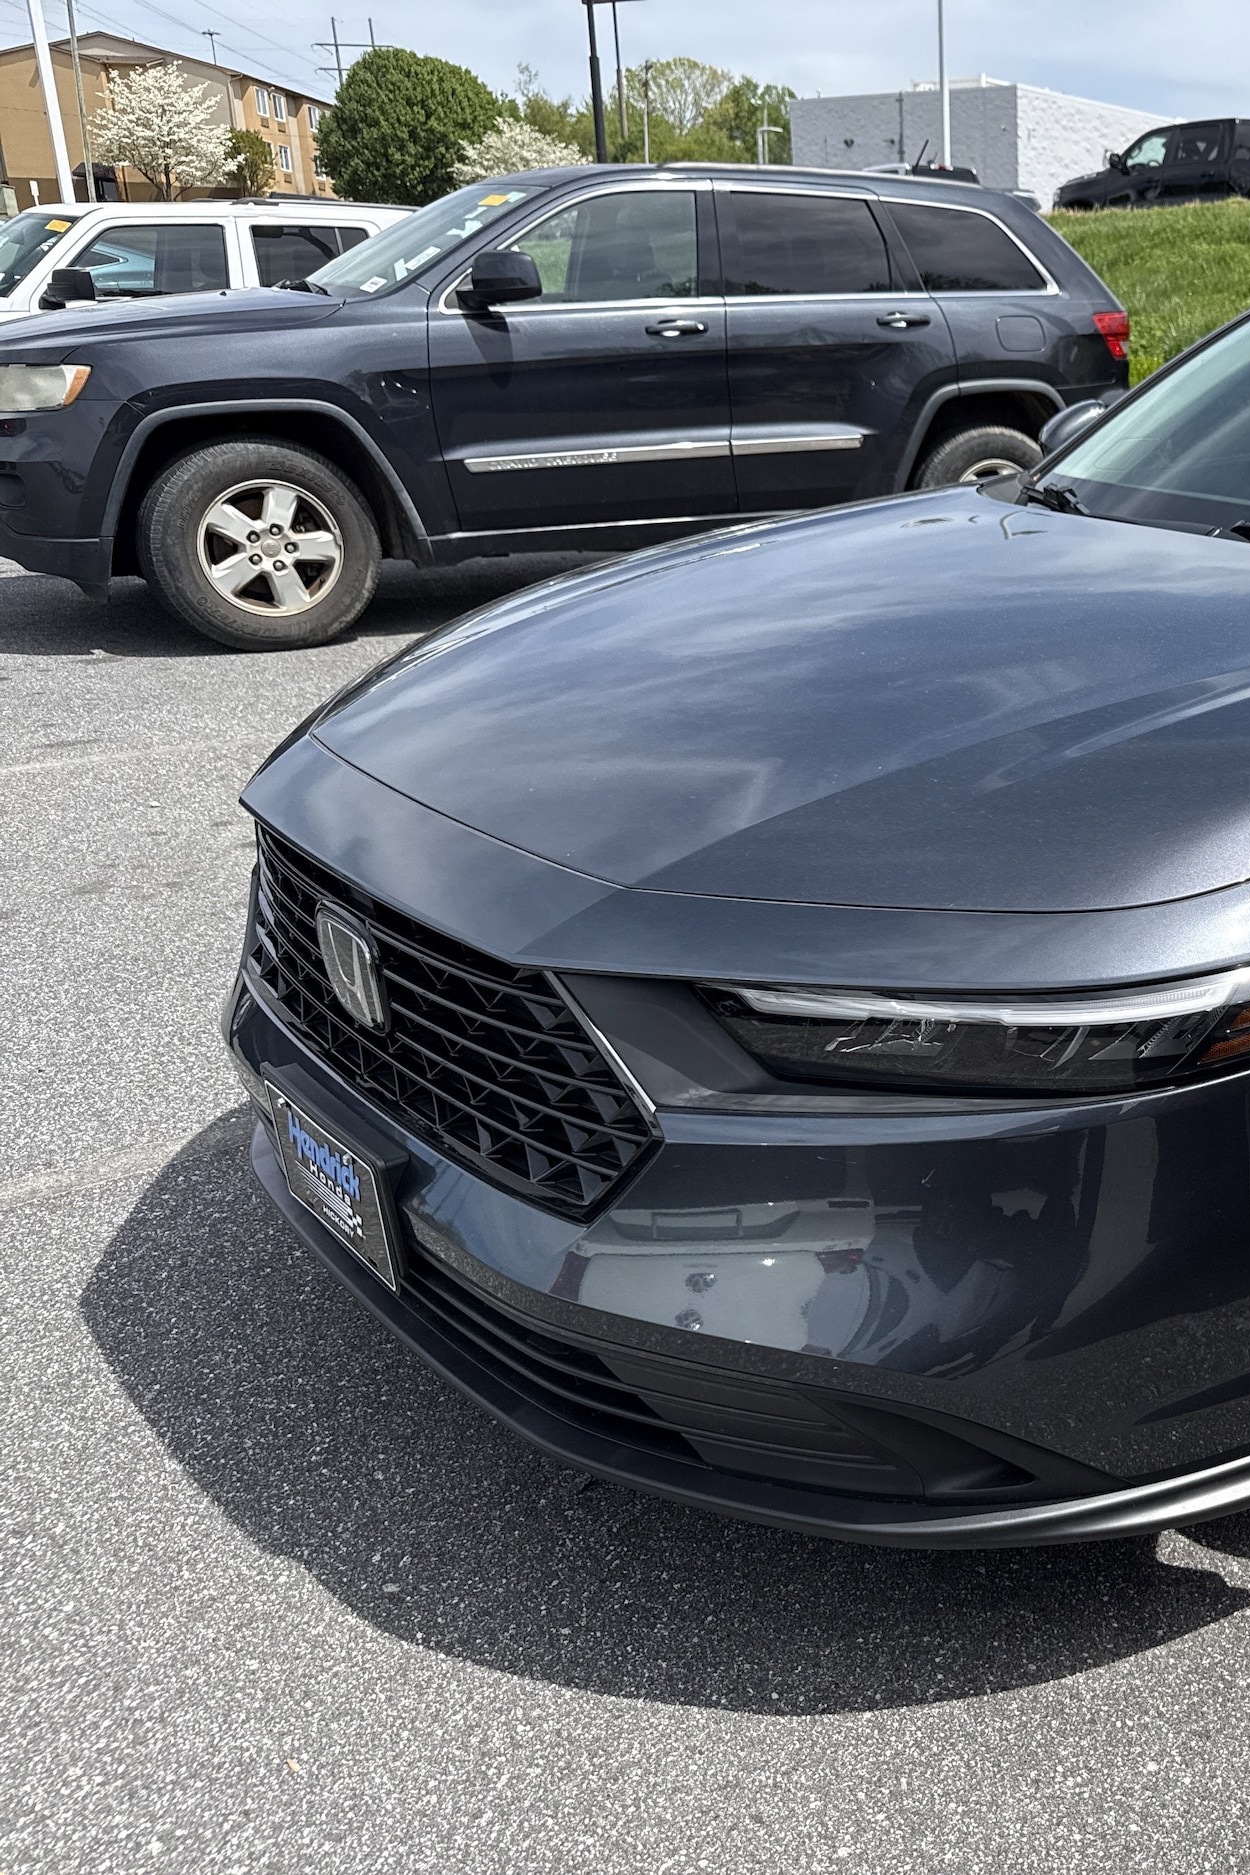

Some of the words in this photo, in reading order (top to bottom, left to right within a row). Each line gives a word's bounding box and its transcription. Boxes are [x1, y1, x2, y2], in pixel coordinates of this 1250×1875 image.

[287, 1109, 360, 1201] Hendrick
[309, 1159, 351, 1206] Honda
[322, 1204, 354, 1237] HICKORY
